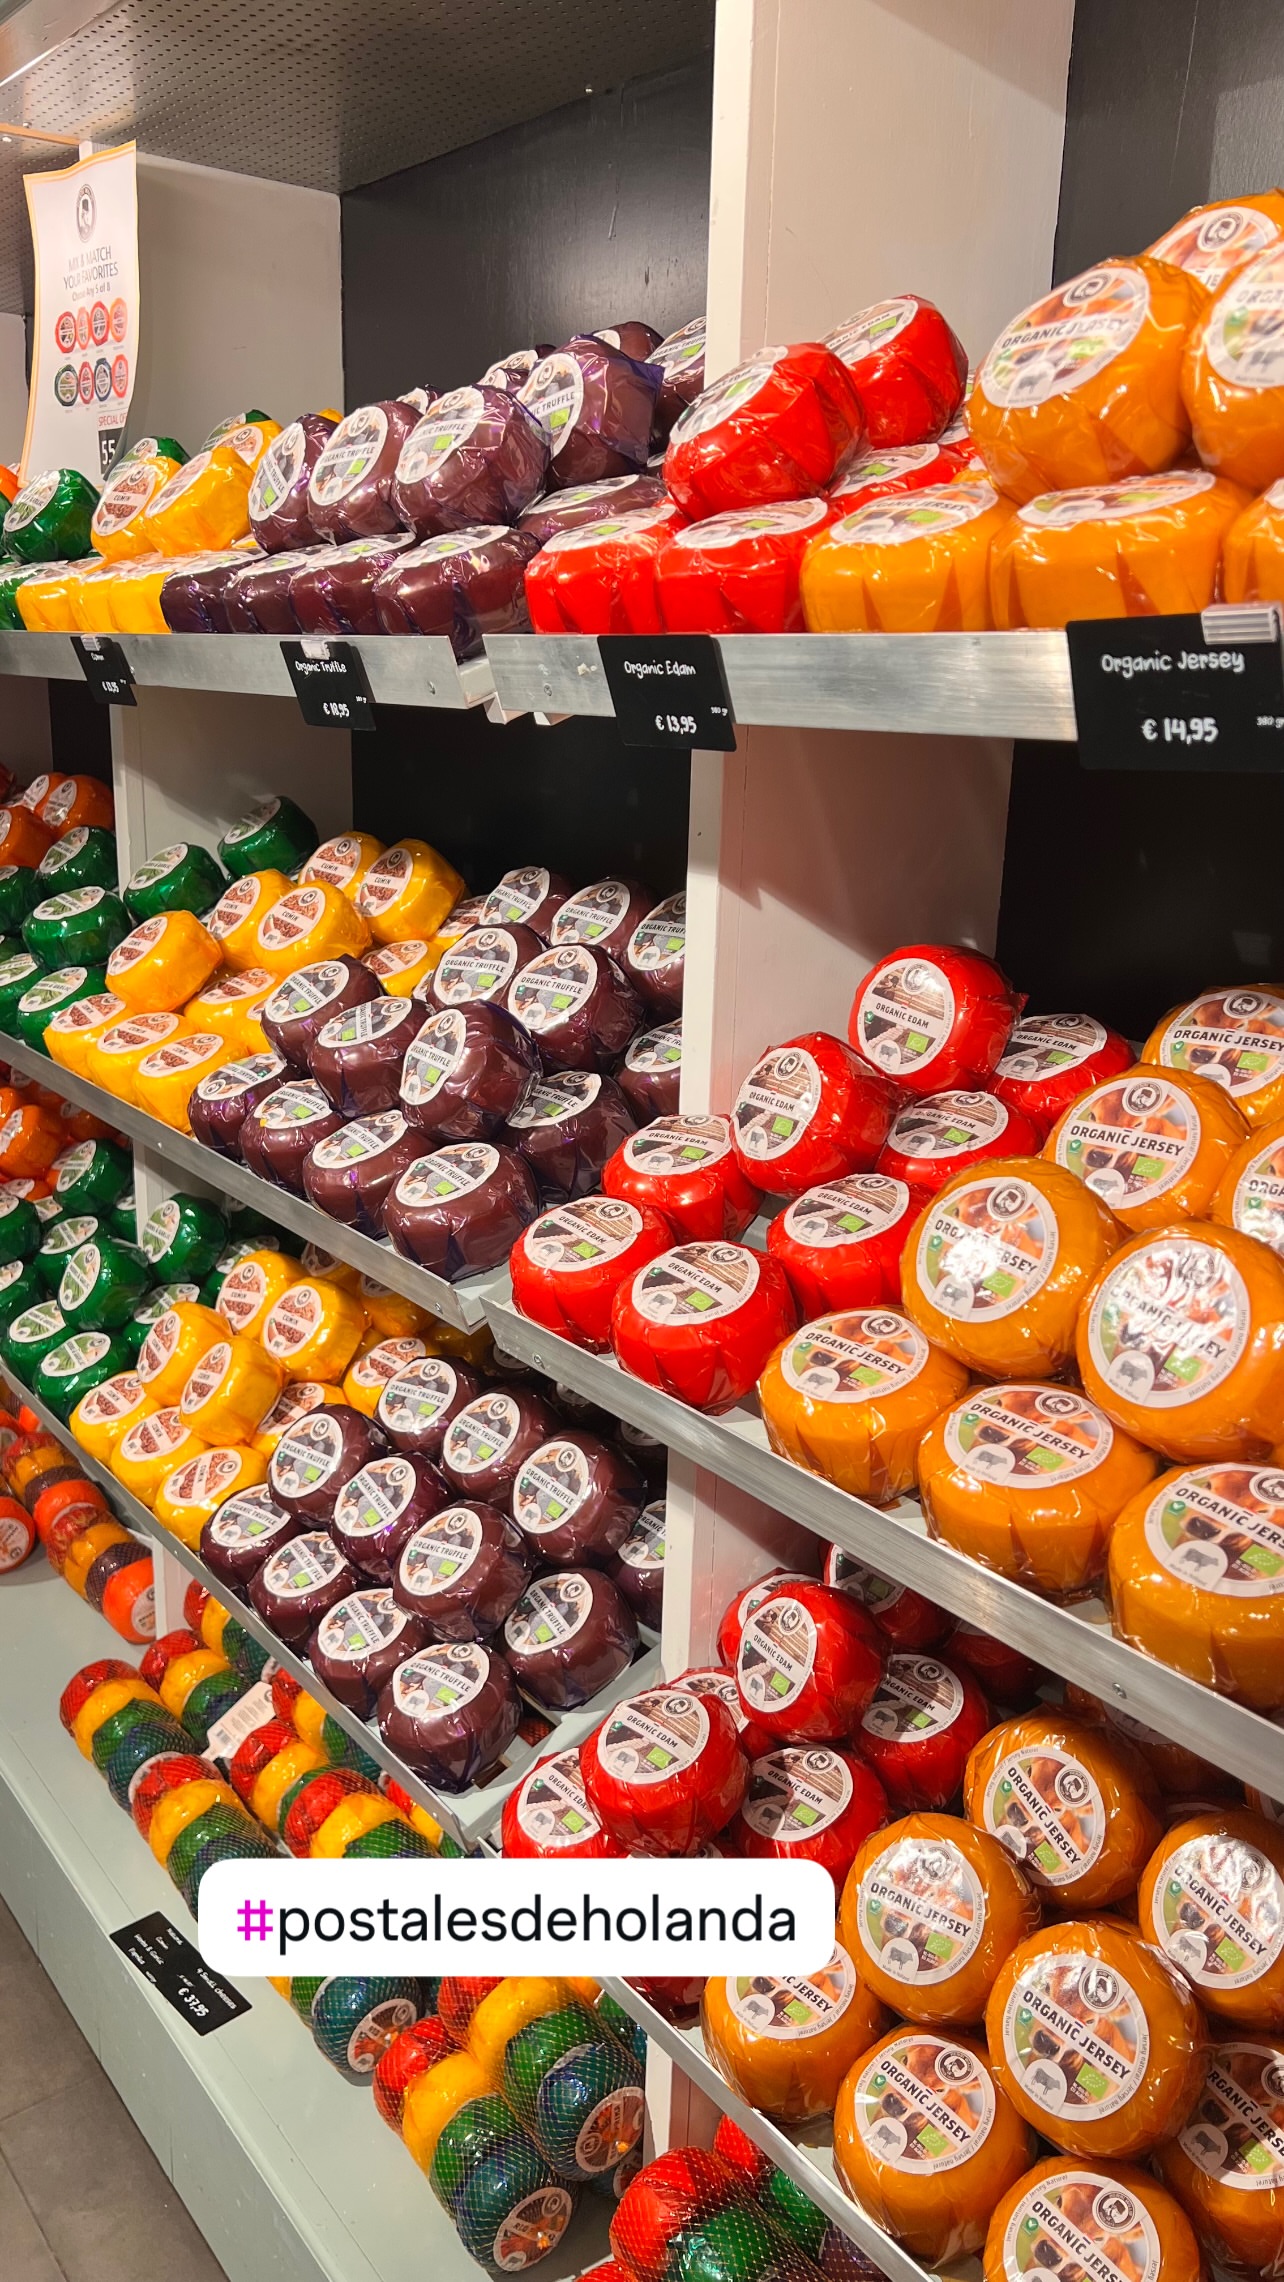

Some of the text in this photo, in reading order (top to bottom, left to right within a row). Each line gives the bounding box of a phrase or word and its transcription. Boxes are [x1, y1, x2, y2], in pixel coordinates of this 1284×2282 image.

[86, 246, 112, 267] MATCH
[82, 262, 119, 286] FAVORITES
[1002, 324, 1066, 347] ORGANIC
[541, 392, 575, 411] TRUFFLE
[295, 661, 347, 675] Organic Truffle
[624, 659, 696, 679] Organic Edam
[1101, 650, 1245, 677] Organic Jersey
[323, 703, 330, 714] €
[655, 715, 698, 735] € 13,95
[1141, 718, 1219, 745] € 14,95
[321, 862, 339, 872] CUMIN
[374, 876, 391, 885] CUMIN
[223, 902, 239, 910] CUMIN
[281, 911, 299, 922] CUMIN
[565, 907, 615, 925] ORGANIC TRUFFLE
[641, 922, 667, 933] ORGANIC
[445, 958, 505, 974] ORGANIC TRUFFLE
[520, 976, 584, 995] ORGANIC TRUFFLE
[876, 1002, 930, 1030] ORGANIC EDAM
[1016, 1034, 1078, 1051] ORGANIC EDAM
[1173, 1029, 1284, 1051] ORGANIC JERSEY
[428, 1051, 451, 1068] TRUFFLE
[749, 1091, 795, 1112] ORGANIC EDAM
[949, 1118, 976, 1129] EDAM
[648, 1131, 709, 1146] ORGANIC EDAM
[1070, 1125, 1185, 1156] ORGANIC JERSEY
[424, 1157, 471, 1187] ORGANIC TRUFFLE
[1248, 1179, 1284, 1197] ORGA
[817, 1191, 873, 1216] ORGANIC EDAM
[558, 1215, 607, 1244] ORGANIC EDAM
[667, 1262, 722, 1293] ORGANIC EDAM
[281, 1315, 299, 1325] CUMIN
[804, 1332, 906, 1375] ORGANIC JERSEY
[390, 1384, 446, 1404] ORGANIC TRUFFLE
[458, 1417, 504, 1449] ORGANIC TRUFFLE
[970, 1402, 1091, 1460] ORGANIC JERSEY
[282, 1442, 331, 1468] ORGANIC TRUFFLE
[525, 1467, 575, 1506] ORGANIC TRUFFLE
[229, 1502, 279, 1527] ORGANIC TRUFFLE
[1175, 1486, 1249, 1525] ORGANIC
[413, 1540, 469, 1560] ORGANIC TRUFFLE
[529, 1589, 566, 1636] ORGANIC TRUFFLE
[359, 1617, 381, 1645] TRUFFLE
[753, 1633, 794, 1673] ORGANIC EDAM
[411, 1661, 472, 1693] ORGANIC TRUFFLE
[912, 1693, 936, 1712] EDAM
[626, 1714, 679, 1749] ORGANIC EDAM
[548, 1774, 574, 1797] ORGANIC
[767, 1769, 823, 1805] ORGANIC EDAM
[1008, 1766, 1082, 1865] ORGANIC JERSEY
[870, 1882, 972, 1938] ORGANIC JERSEY
[1222, 1912, 1268, 1957] JERSEY
[177, 1987, 190, 1996] €
[792, 1978, 834, 2014] JERSEY
[183, 1994, 210, 2018] 37,95
[1023, 1990, 1131, 2080] ORGANIC JERSEY
[880, 2060, 971, 2144] ORGANIC JERSEY
[1250, 2110, 1284, 2156] JERSE
[1031, 2200, 1090, 2256] ORGANIC
